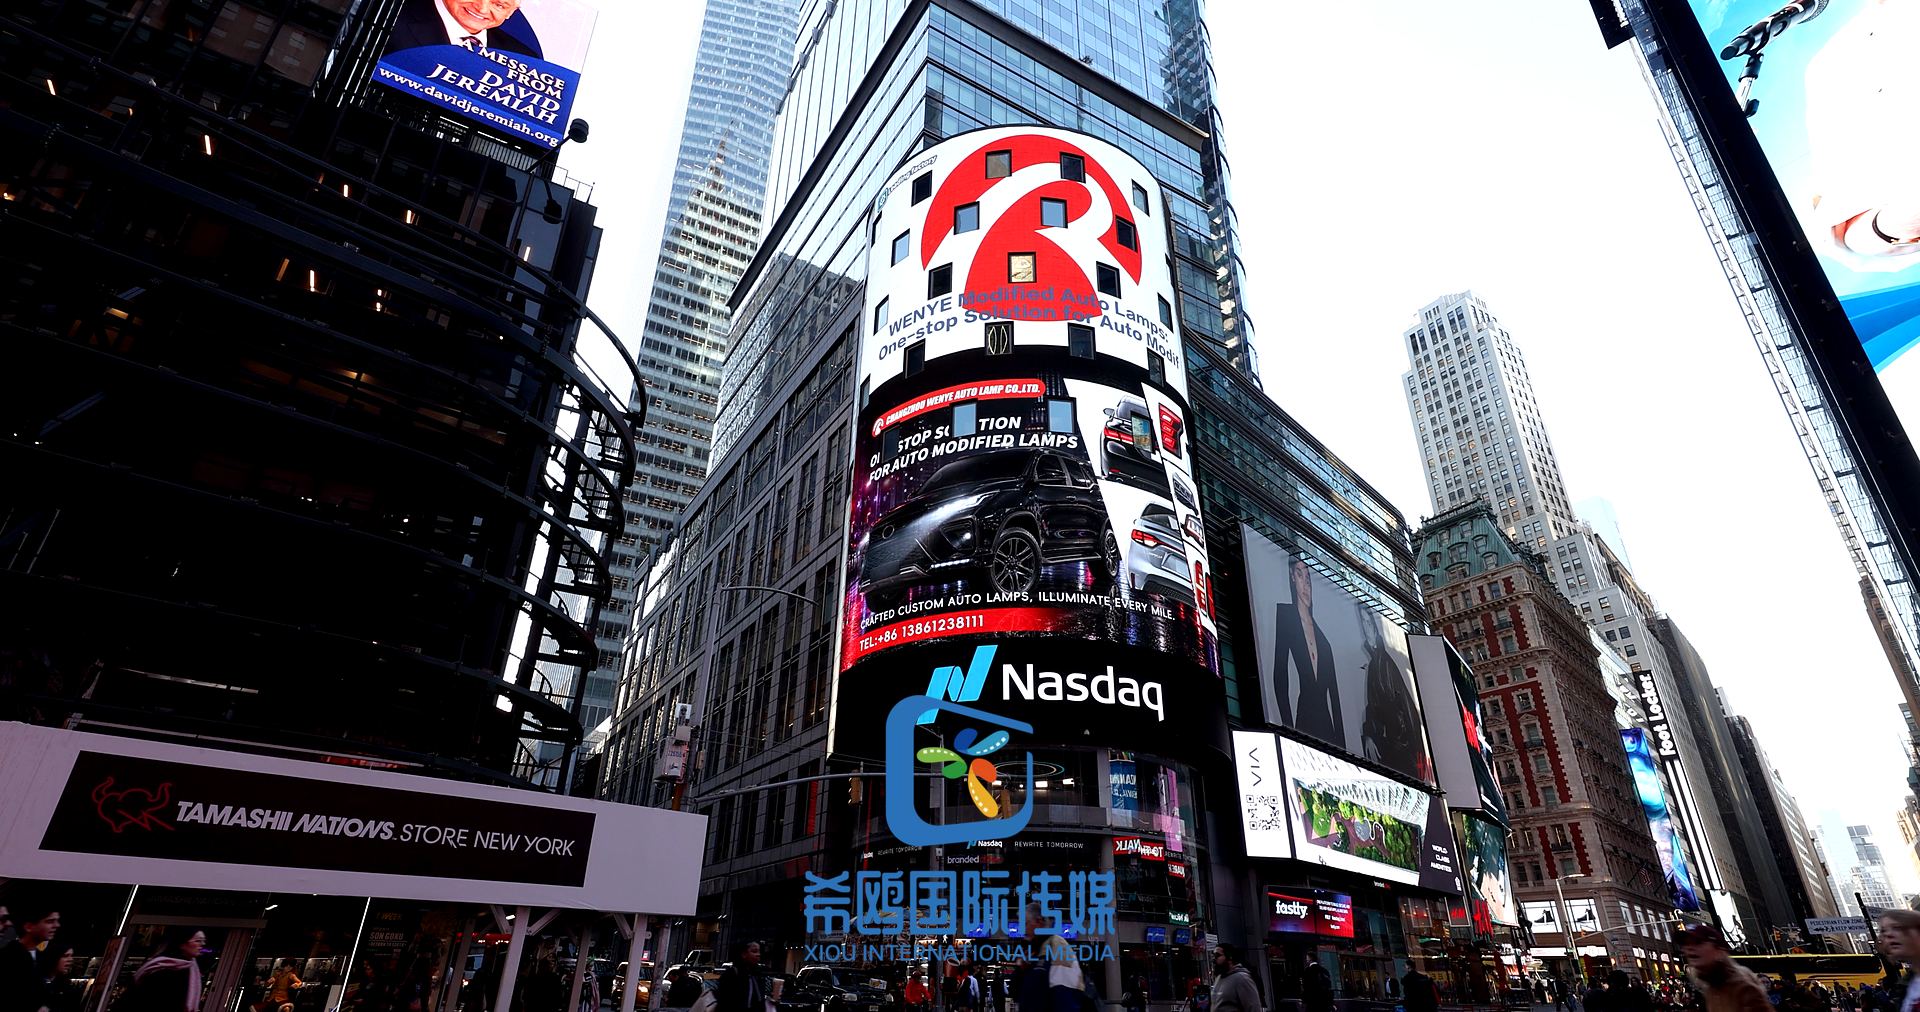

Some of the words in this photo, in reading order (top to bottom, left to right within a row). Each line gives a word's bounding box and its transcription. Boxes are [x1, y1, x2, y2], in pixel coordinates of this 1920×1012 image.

[458, 38, 475, 53] A
[477, 42, 566, 92] MESSAGE
[506, 68, 562, 100] FROM
[378, 66, 560, 149] www.davidjeremiah.org
[426, 63, 559, 126] JEREMIAH
[478, 70, 560, 113] DAVID
[878, 316, 958, 361] One-stop
[964, 304, 1057, 324] Solution
[1063, 304, 1092, 324] for
[1100, 314, 1142, 342] Auto
[888, 296, 953, 336] WENYE
[958, 286, 1054, 308] Modified
[1061, 288, 1110, 310] Auto
[1114, 300, 1170, 342] Lamps:
[885, 400, 926, 426] CHANGZHOU
[926, 391, 955, 407] WENYE
[954, 387, 978, 400] AUTO
[978, 384, 1004, 396] LAMP
[870, 463, 891, 482] FOR
[890, 447, 929, 473] AUTO
[931, 434, 1015, 458] MODIFIED
[1018, 433, 1079, 449] LAMPS
[859, 630, 898, 652] TEL:+86
[901, 614, 984, 638] 13861238111
[860, 609, 895, 630] CRAFTED
[897, 598, 944, 616] CUSTOM
[948, 593, 982, 607] AUTO
[986, 591, 1033, 604] LAMPS,
[1038, 591, 1111, 607] ILLUMINATE
[1114, 597, 1148, 613] EVERY
[1151, 604, 1176, 621] MILE.
[1002, 663, 1164, 722] Nasdaq
[1639, 673, 1665, 722] Locker
[1653, 723, 1676, 756] Foot
[176, 800, 293, 831] TAMASHII
[292, 808, 394, 840] NATIONS
[400, 822, 469, 849] STORE
[473, 830, 521, 851] NEW
[524, 834, 576, 857] YORK
[978, 838, 1004, 849] Nasdaq
[1014, 840, 1044, 848] REWRITE
[1046, 841, 1084, 850] TOMORROW
[946, 855, 980, 864] branded
